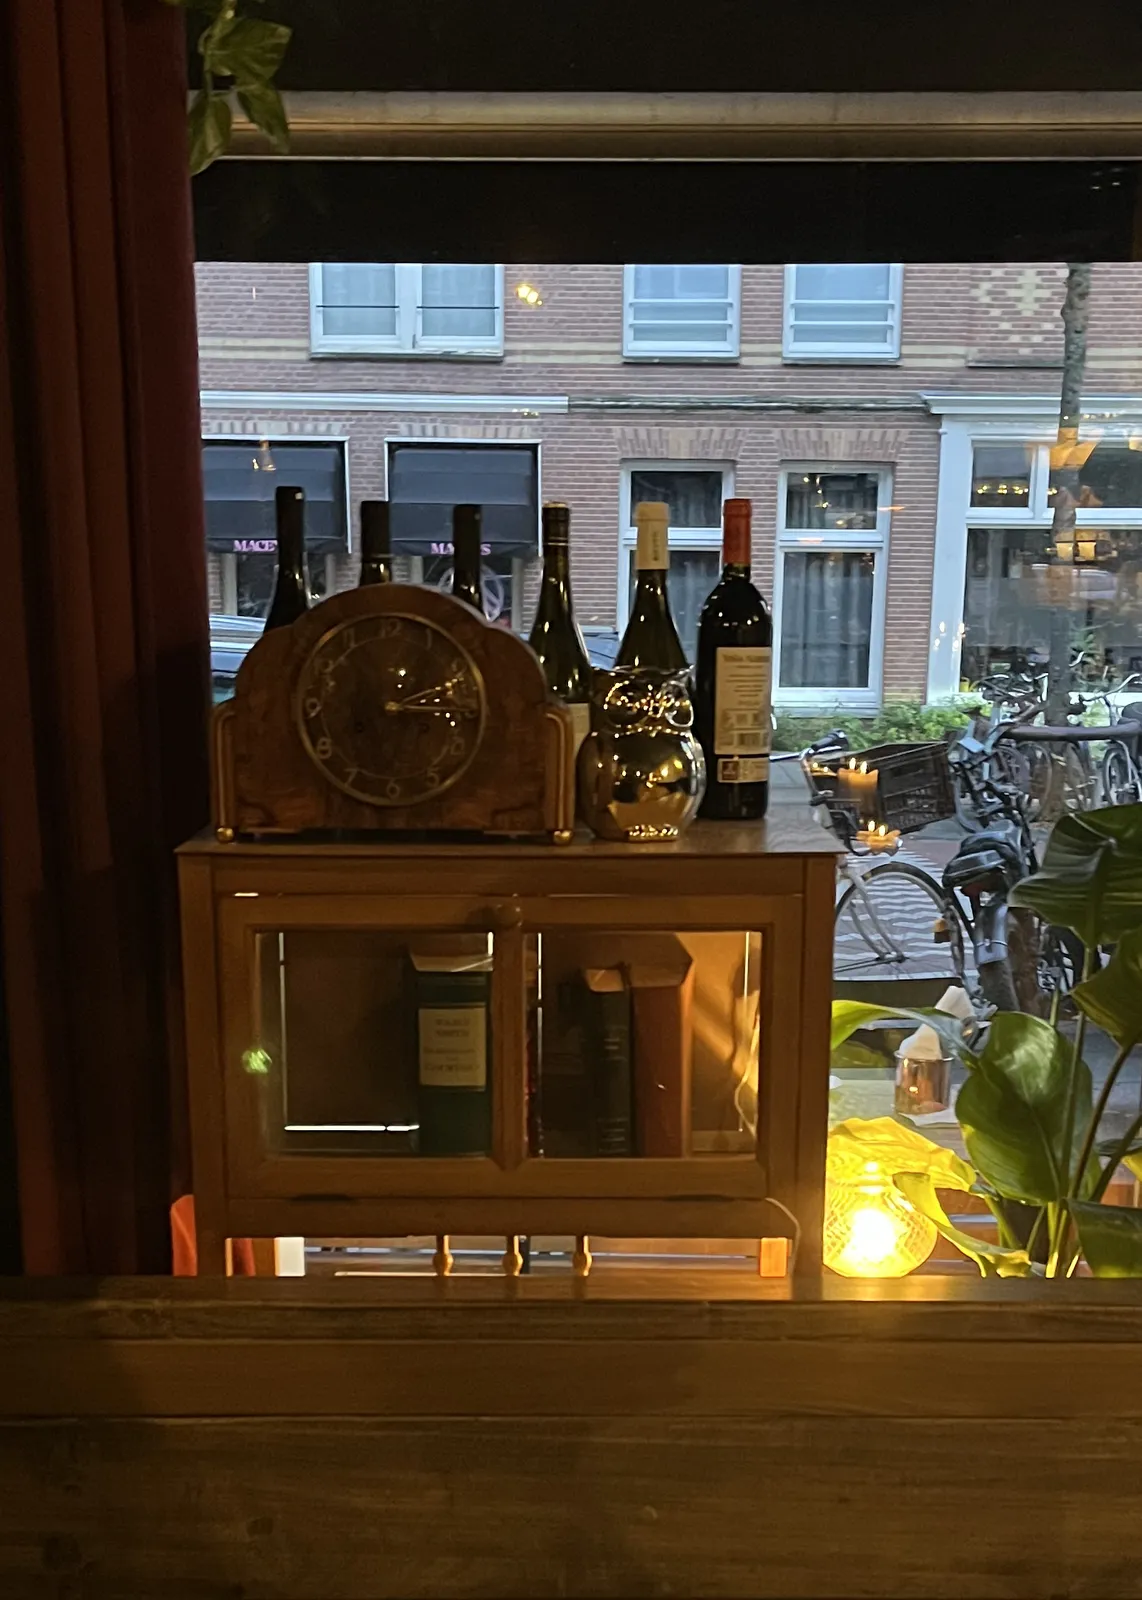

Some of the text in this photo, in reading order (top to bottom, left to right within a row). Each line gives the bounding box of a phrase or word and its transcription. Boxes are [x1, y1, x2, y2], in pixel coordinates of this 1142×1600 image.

[344, 628, 356, 649] 11
[380, 618, 402, 638] 12
[304, 697, 322, 719] 9
[316, 737, 332, 760] 8
[343, 767, 358, 788] 7
[425, 767, 440, 788] 5
[386, 778, 401, 799] 6
